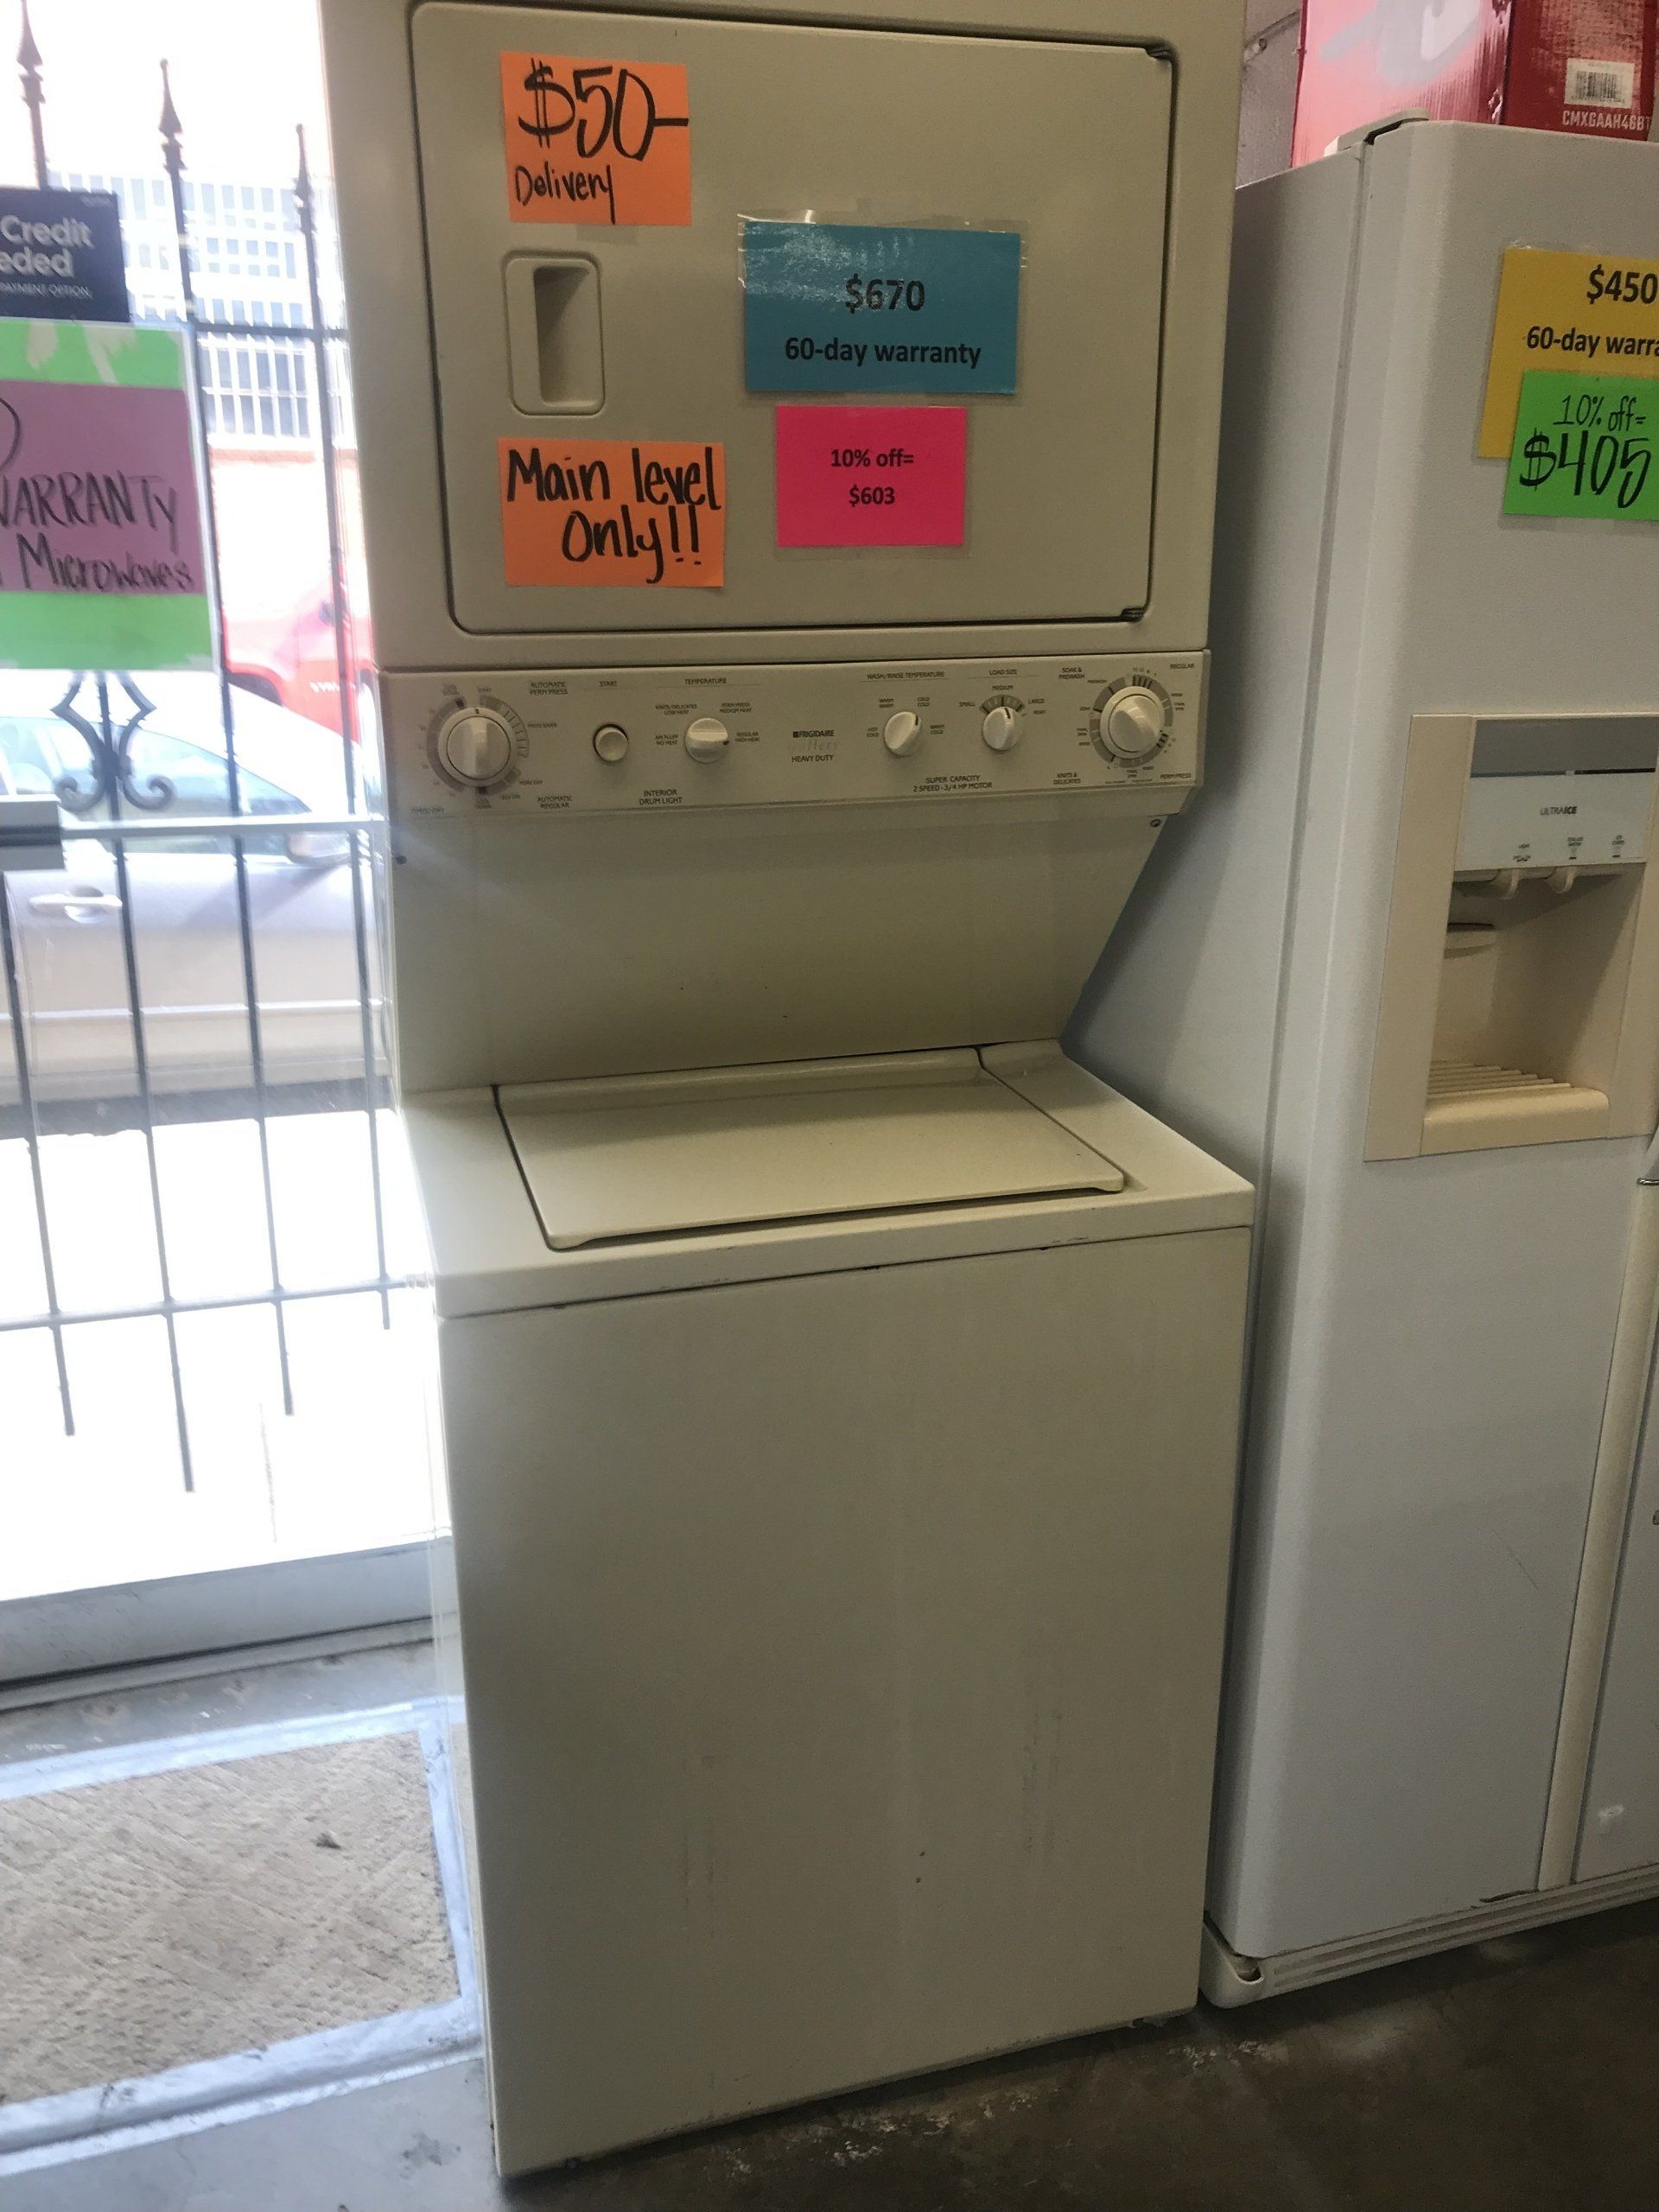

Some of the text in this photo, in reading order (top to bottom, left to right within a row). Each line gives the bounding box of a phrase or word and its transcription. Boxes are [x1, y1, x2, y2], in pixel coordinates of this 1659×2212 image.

[515, 161, 616, 225] Delivery
[0, 214, 94, 250] Credit
[844, 274, 925, 315] $670
[1586, 264, 1659, 304] $450
[785, 336, 981, 372] 60-day warranty
[1527, 325, 1600, 359] 60-day
[1553, 394, 1605, 428] 10%
[830, 448, 914, 468] 10% off=
[1520, 428, 1651, 509] $405
[506, 446, 722, 511] Main level
[849, 486, 895, 507] $603
[561, 505, 702, 584] Only!!
